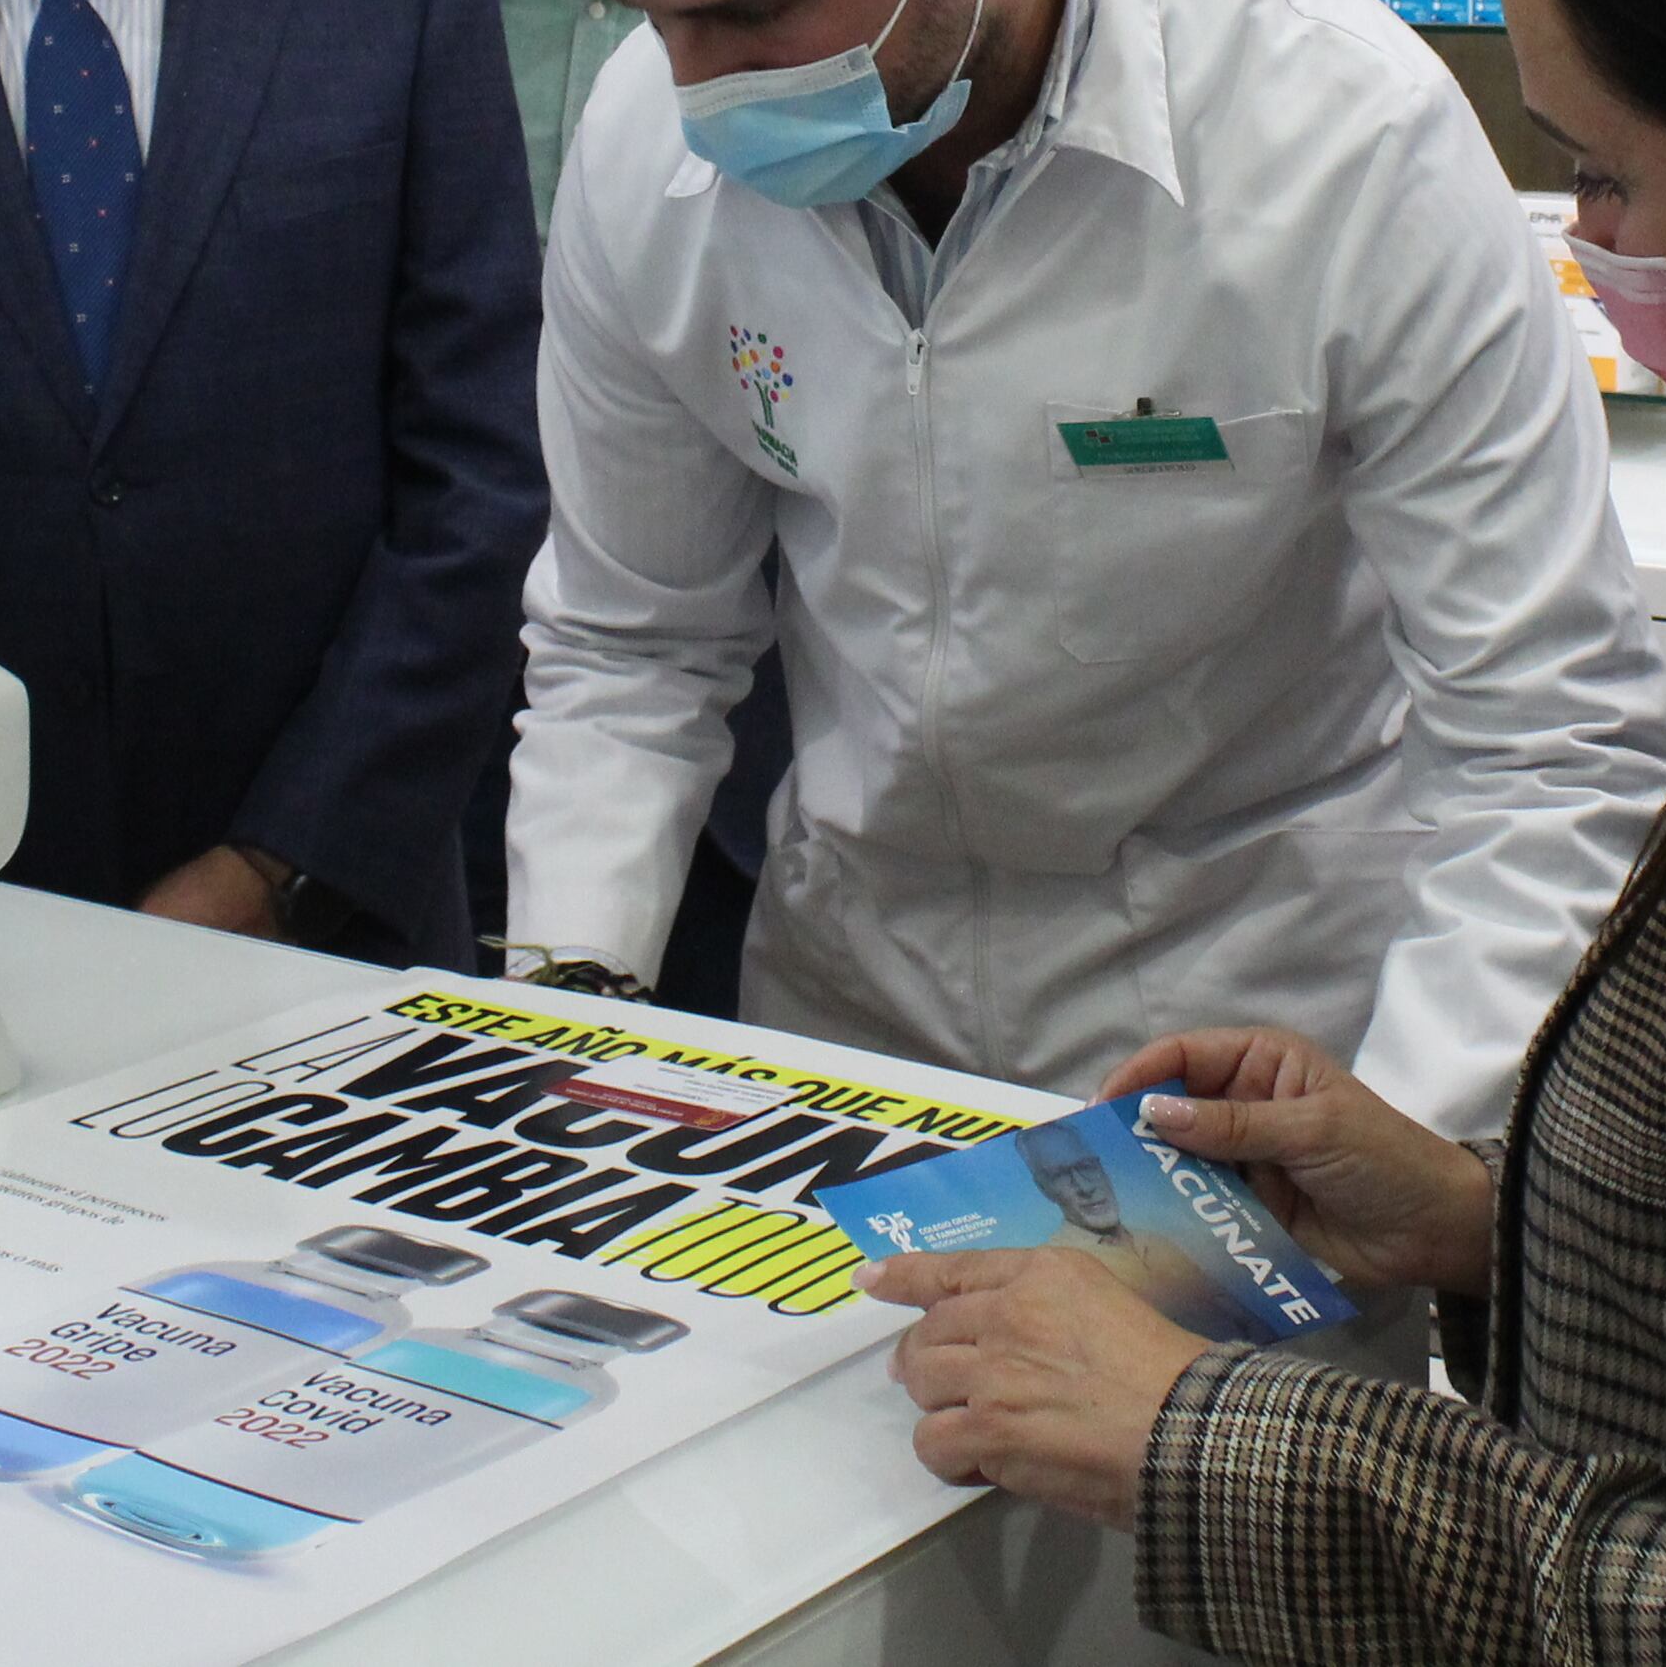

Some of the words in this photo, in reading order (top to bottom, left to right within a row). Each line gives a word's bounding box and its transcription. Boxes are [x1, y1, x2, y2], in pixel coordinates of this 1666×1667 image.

[384, 992, 533, 1041] ESTE
[509, 1026, 649, 1063] AÑO
[781, 1080, 907, 1122] QUE
[68, 1069, 276, 1140] LO
[230, 1015, 419, 1084] LA
[337, 1031, 961, 1210] VACUN
[162, 1092, 701, 1262] CAMBIA
[1132, 1118, 1321, 1326] VACÚNATE
[600, 1196, 870, 1317] TODO
[3, 1337, 117, 1382] 2022
[49, 1320, 158, 1364] Gripe
[95, 1300, 238, 1358] Vacuna
[213, 1406, 331, 1450] 2022
[257, 1388, 387, 1434] Covid
[302, 1368, 453, 1428] Vacuna
